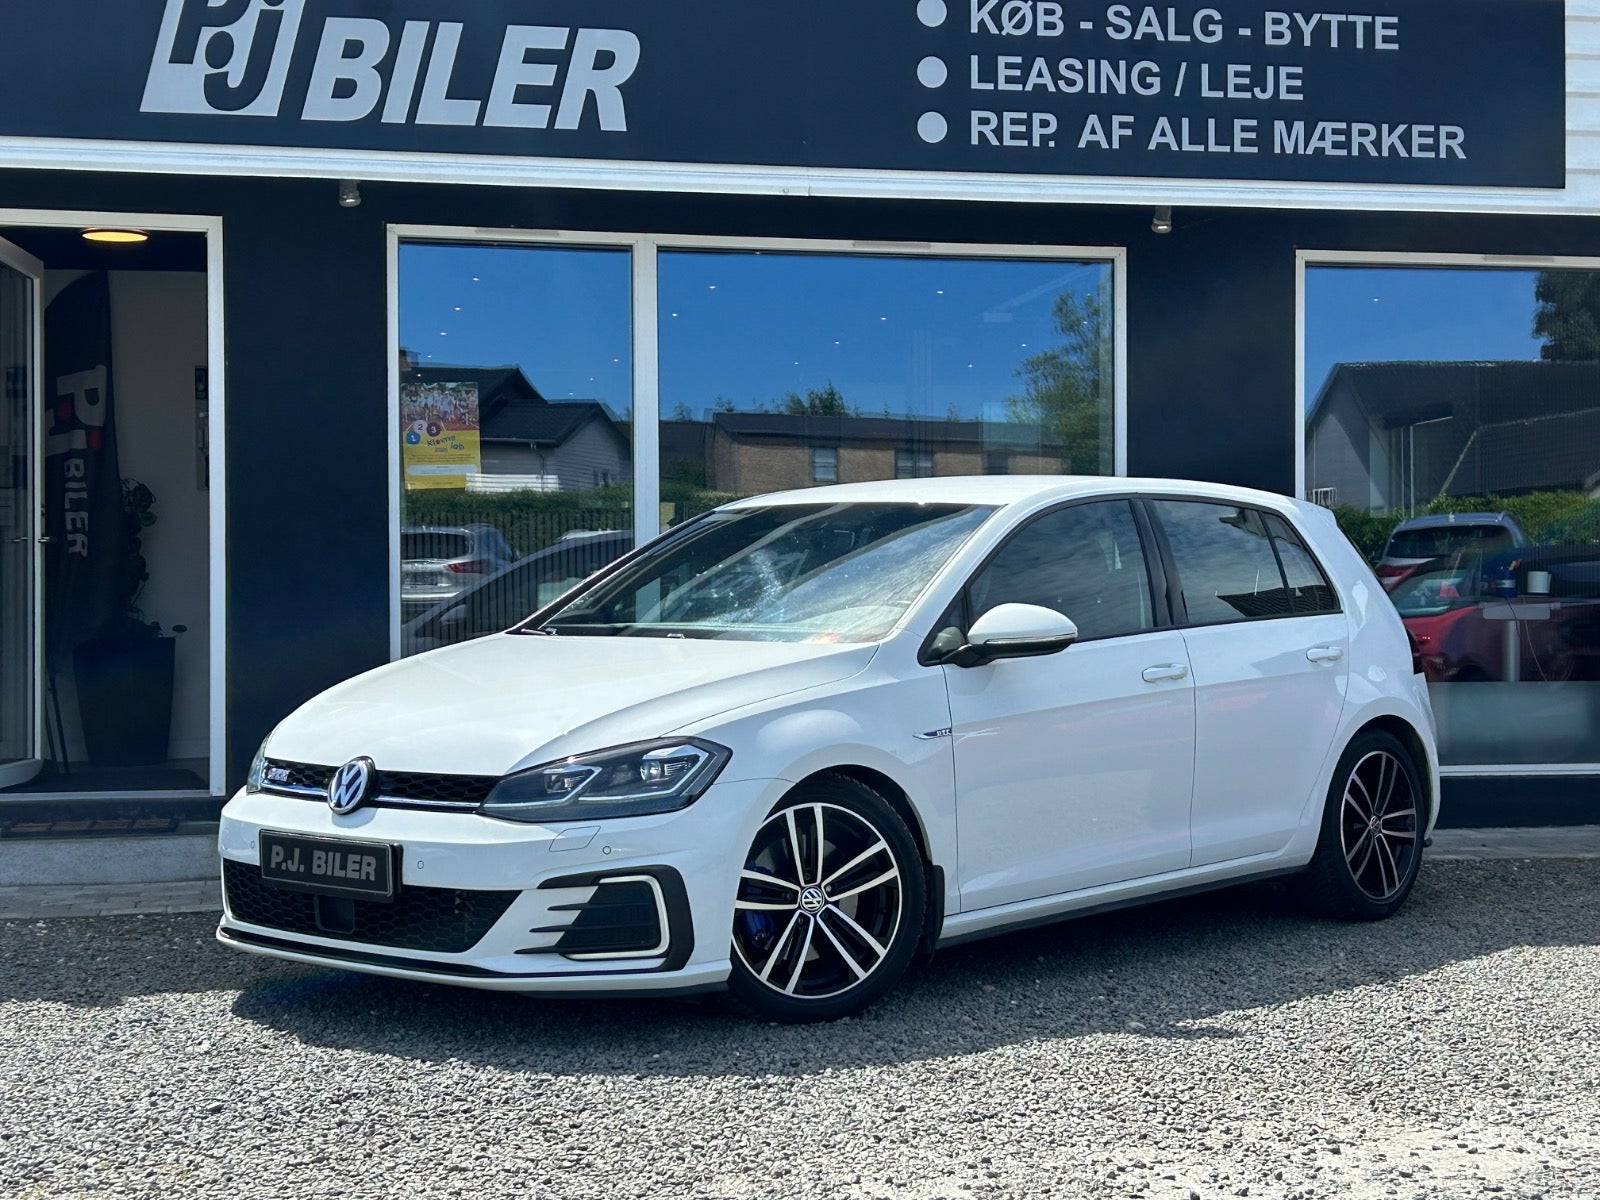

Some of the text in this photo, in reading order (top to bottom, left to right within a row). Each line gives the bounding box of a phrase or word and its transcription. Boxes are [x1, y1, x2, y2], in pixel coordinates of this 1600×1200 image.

[969, 0, 1065, 38] KØB
[1106, 4, 1224, 43] SALG
[1265, 12, 1399, 50] BYTTE
[301, 17, 641, 132] BILER
[970, 55, 1162, 95] LEASING
[1201, 64, 1305, 101] LEJE
[970, 111, 1467, 159] REP. AF ALLE MÆRKER
[64, 458, 88, 558] BILER
[270, 845, 376, 881] P.J. BILER
